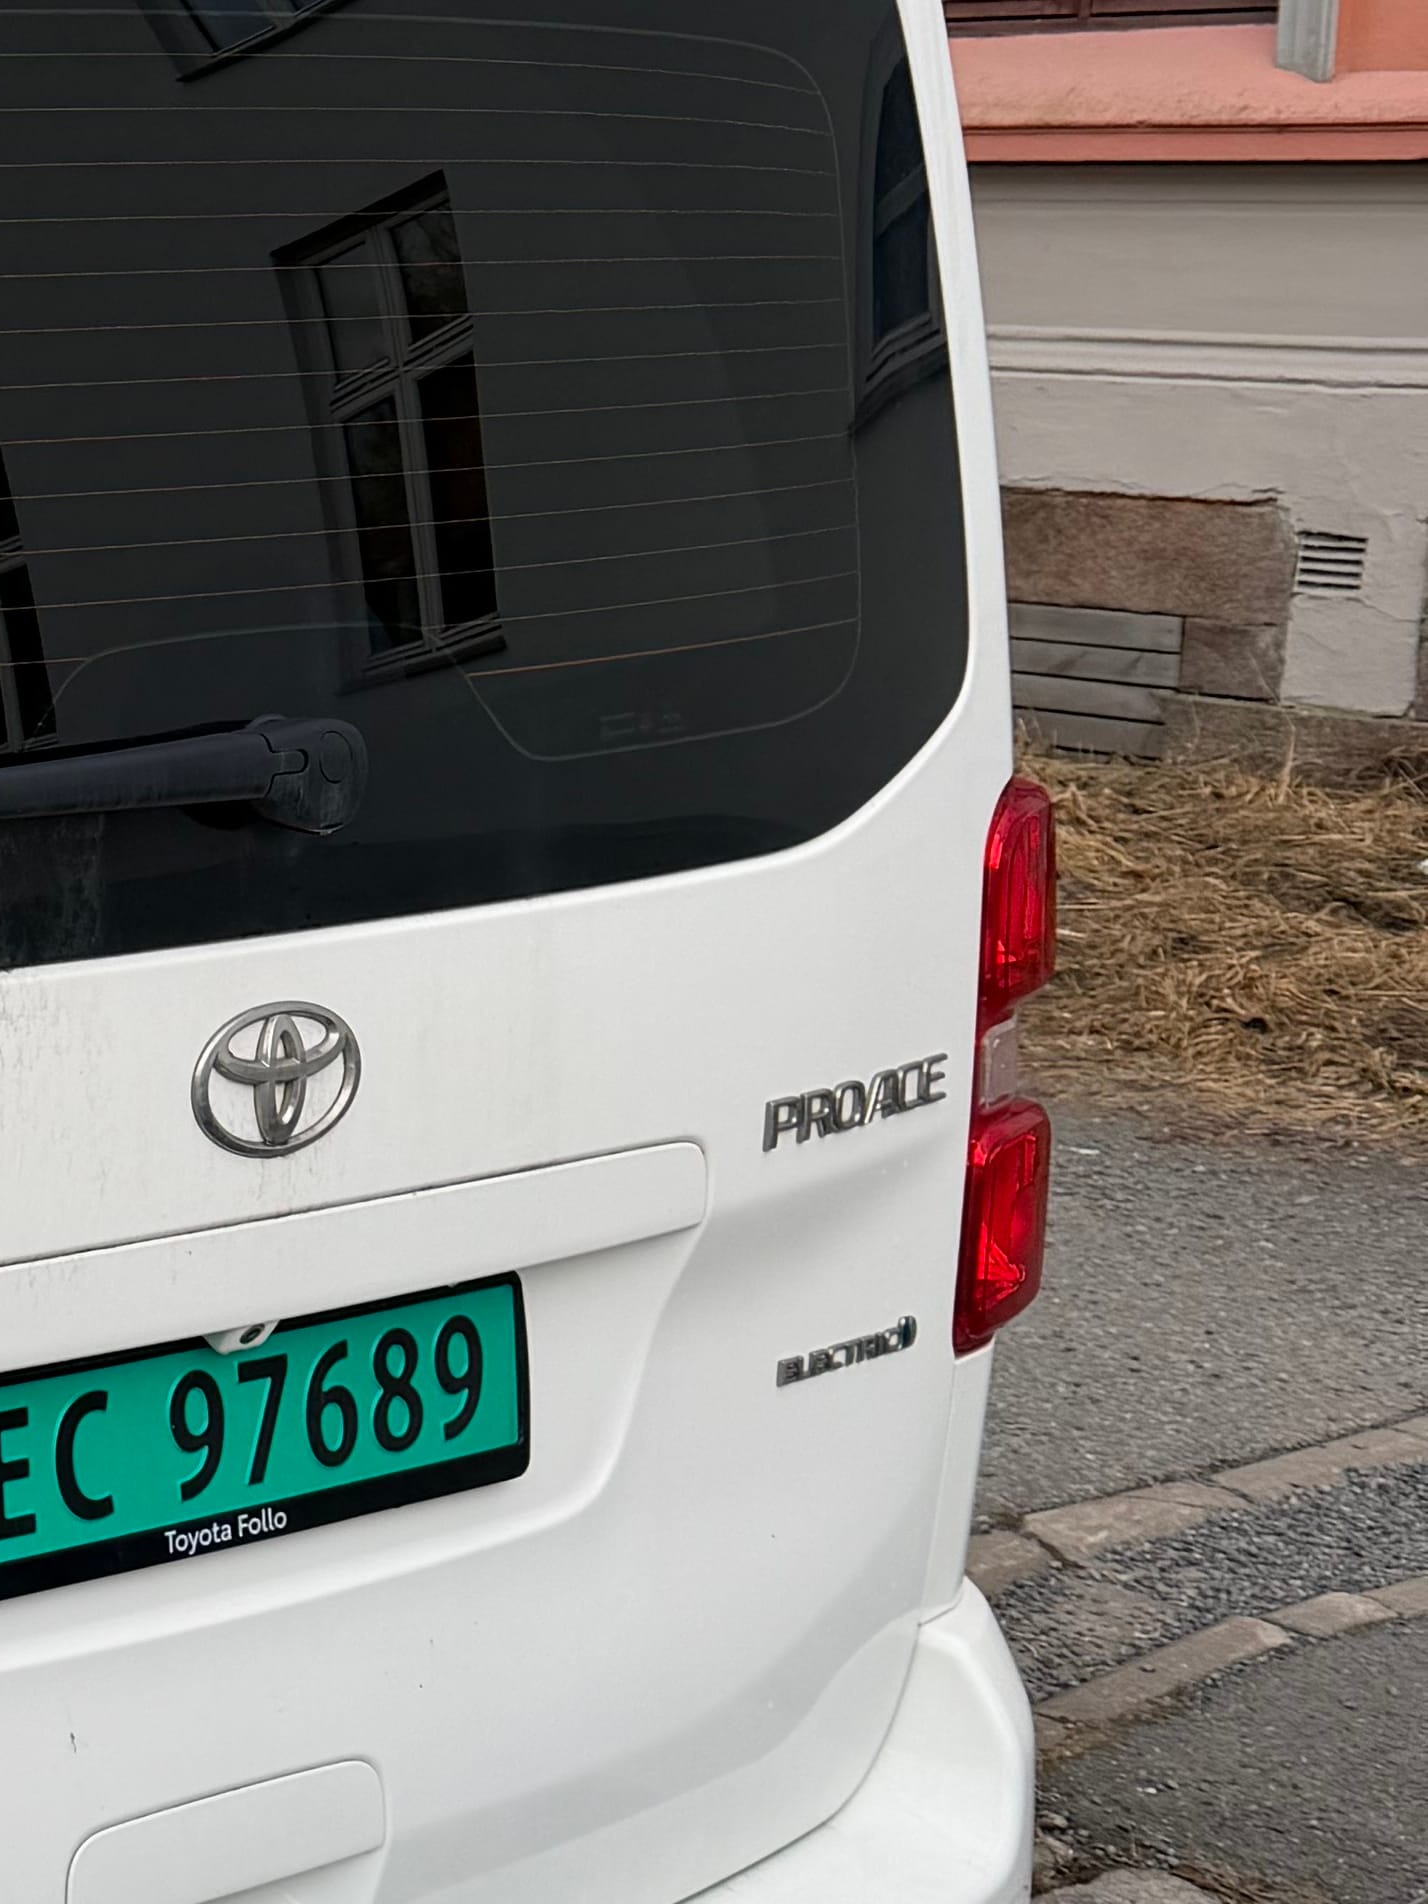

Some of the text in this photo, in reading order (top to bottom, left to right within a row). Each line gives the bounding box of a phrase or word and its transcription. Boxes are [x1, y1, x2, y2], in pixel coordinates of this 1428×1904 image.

[762, 1052, 948, 1152] PROACE
[168, 1313, 484, 1503] 97689
[164, 1507, 287, 1555] Toyota Follo
